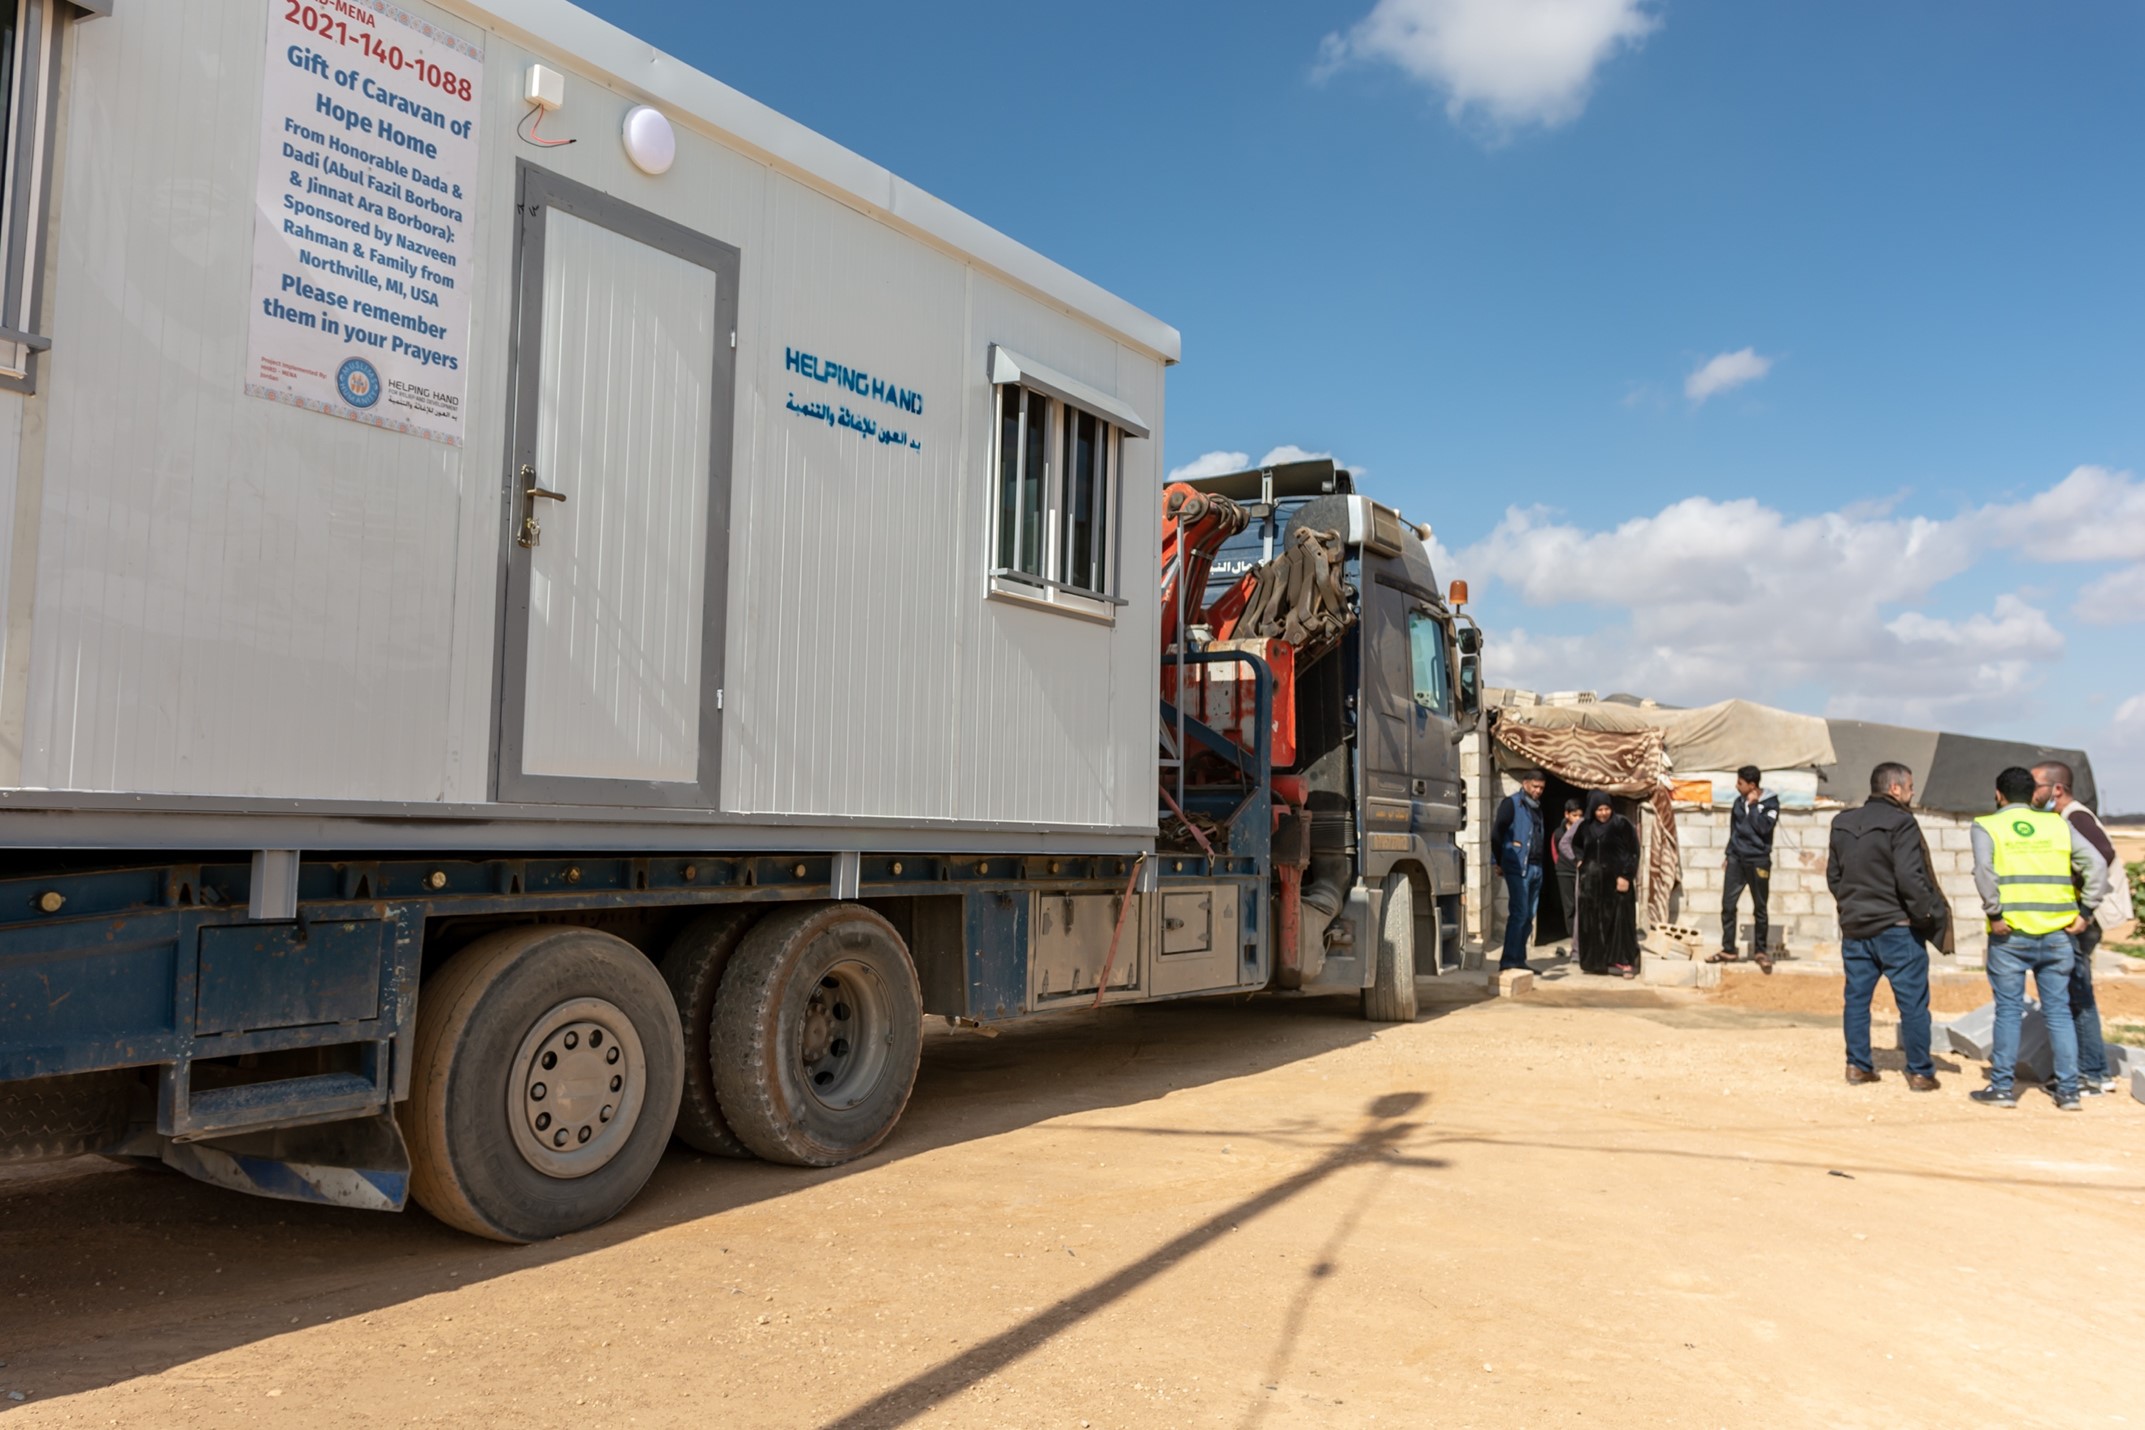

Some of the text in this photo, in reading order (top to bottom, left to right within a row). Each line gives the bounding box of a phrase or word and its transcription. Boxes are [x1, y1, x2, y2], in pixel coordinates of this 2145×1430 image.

[285, 0, 472, 102] 2021-140-1088
[287, 45, 472, 140] Gift of Caravan of
[316, 93, 438, 159] Hope Home
[282, 142, 463, 222] Dadi (Abul Fazil Borbora
[284, 117, 463, 200] From Honorable Dada &
[283, 194, 457, 267] Sponsored by Nazveen
[289, 170, 455, 243] & Jinnat Ara Borbora):
[283, 219, 454, 289] Rahman & Family from
[299, 249, 439, 308] Northville, MI, USA
[263, 297, 458, 370] them in your Prayers
[281, 273, 447, 340] Please remember
[388, 379, 459, 406] HELPING HAND
[785, 347, 923, 416] HELPING HAND
